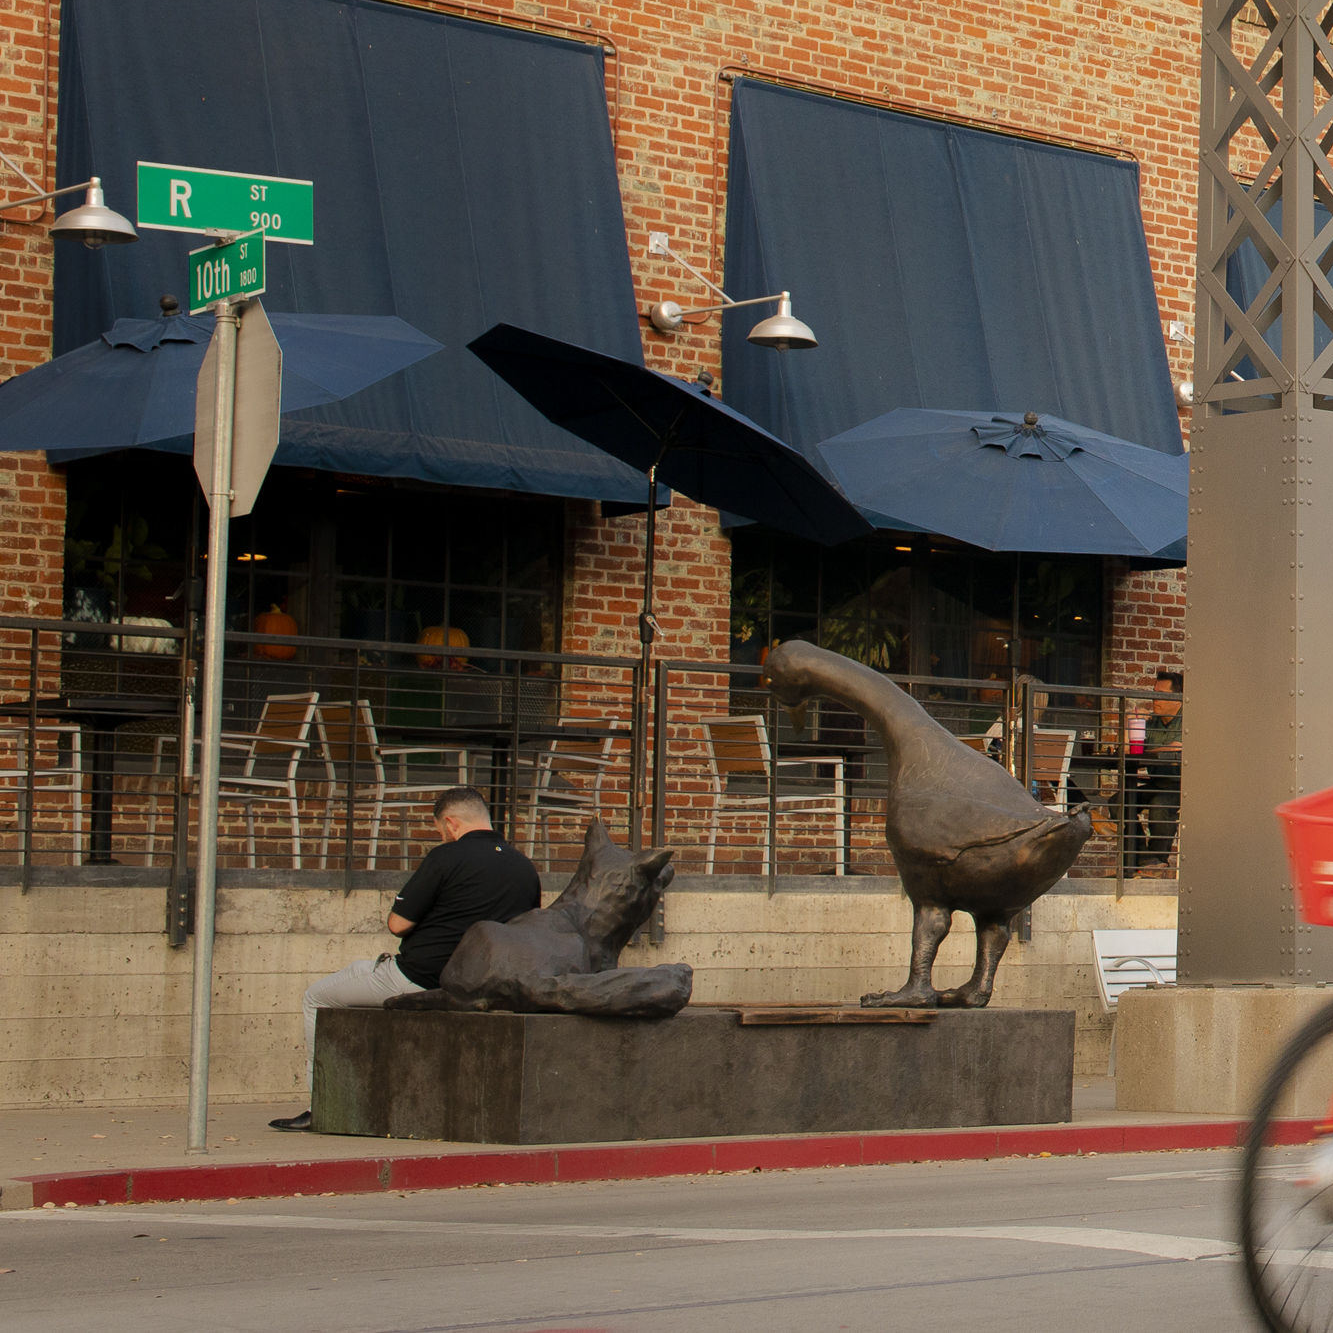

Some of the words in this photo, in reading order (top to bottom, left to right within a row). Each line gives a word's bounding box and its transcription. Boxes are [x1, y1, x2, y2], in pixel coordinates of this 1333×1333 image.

[170, 179, 192, 218] R
[250, 184, 268, 202] ST
[250, 211, 281, 230] 900
[196, 257, 230, 301] 10th
[239, 242, 249, 260] ST
[239, 267, 257, 287] 1800
